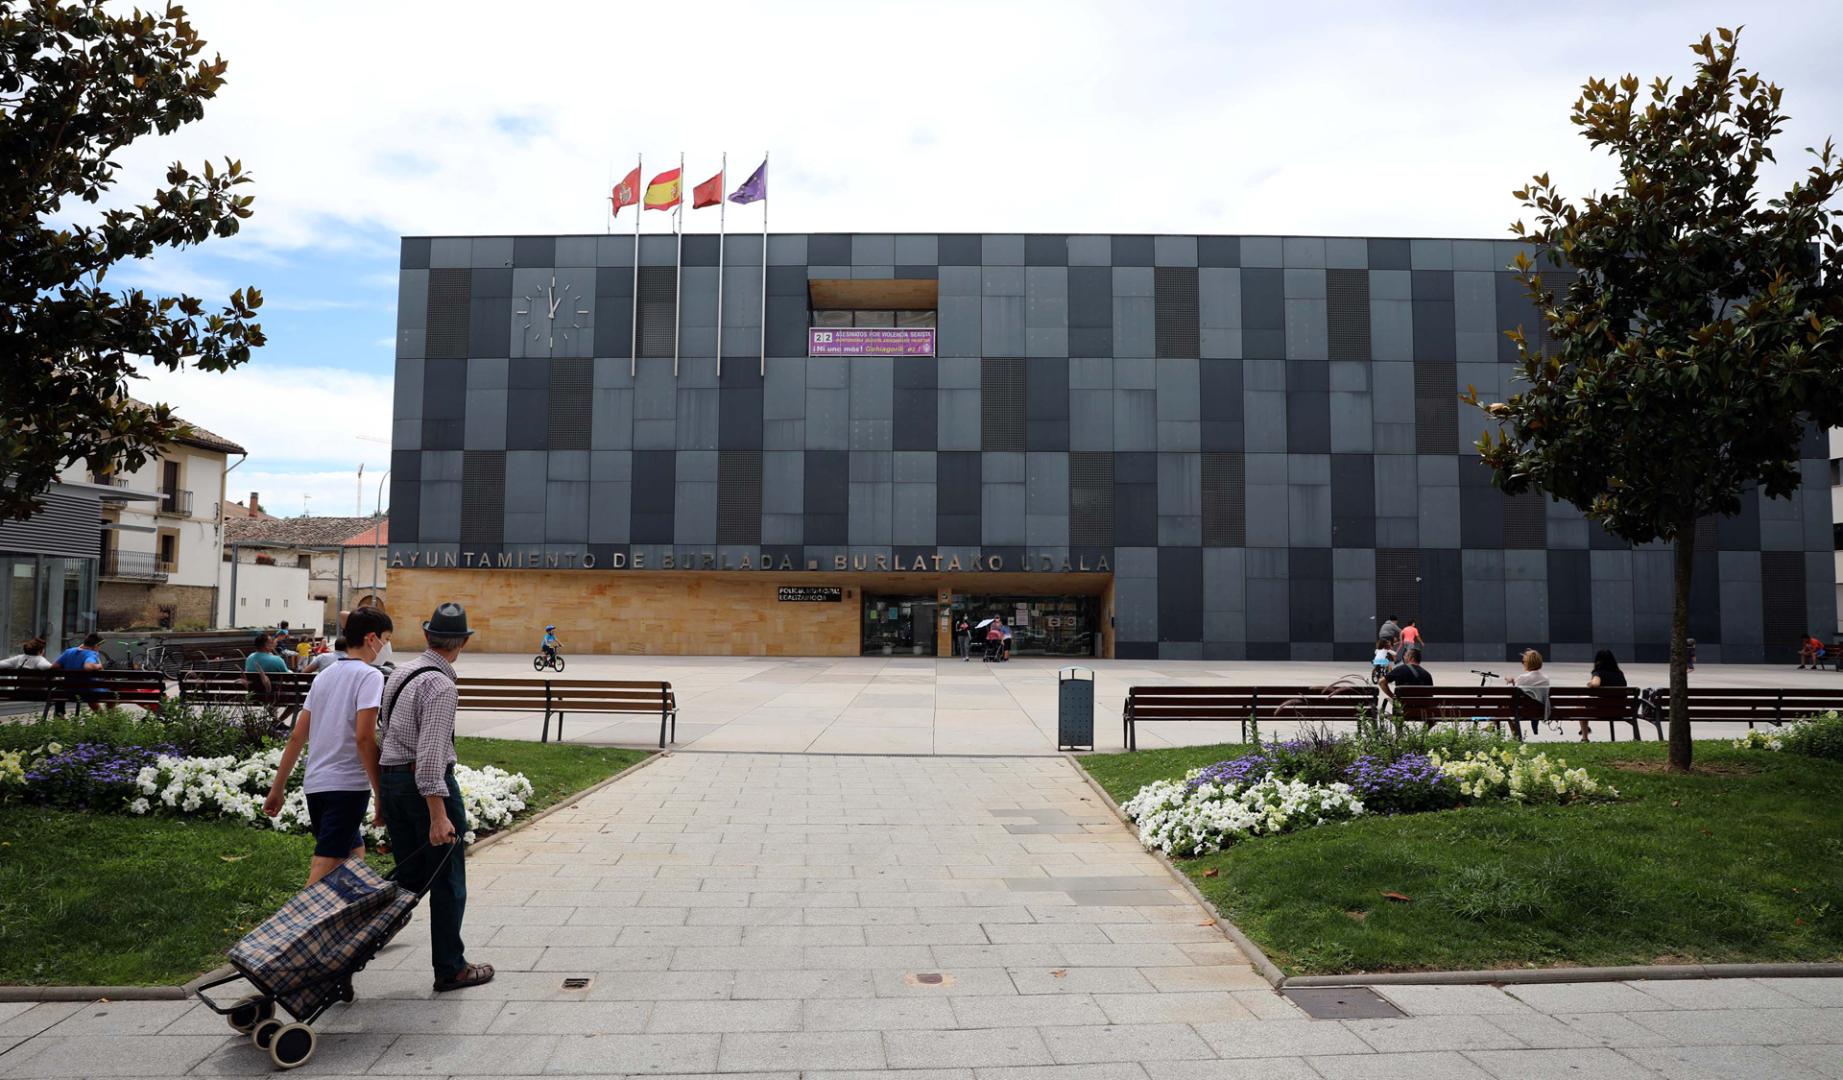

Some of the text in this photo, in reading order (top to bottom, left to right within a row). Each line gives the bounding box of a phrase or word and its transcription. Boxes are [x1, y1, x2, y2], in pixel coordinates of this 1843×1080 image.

[391, 552, 1111, 572] AYUNTAMIENTO DE BURLADA BURLATAKO UDALA
